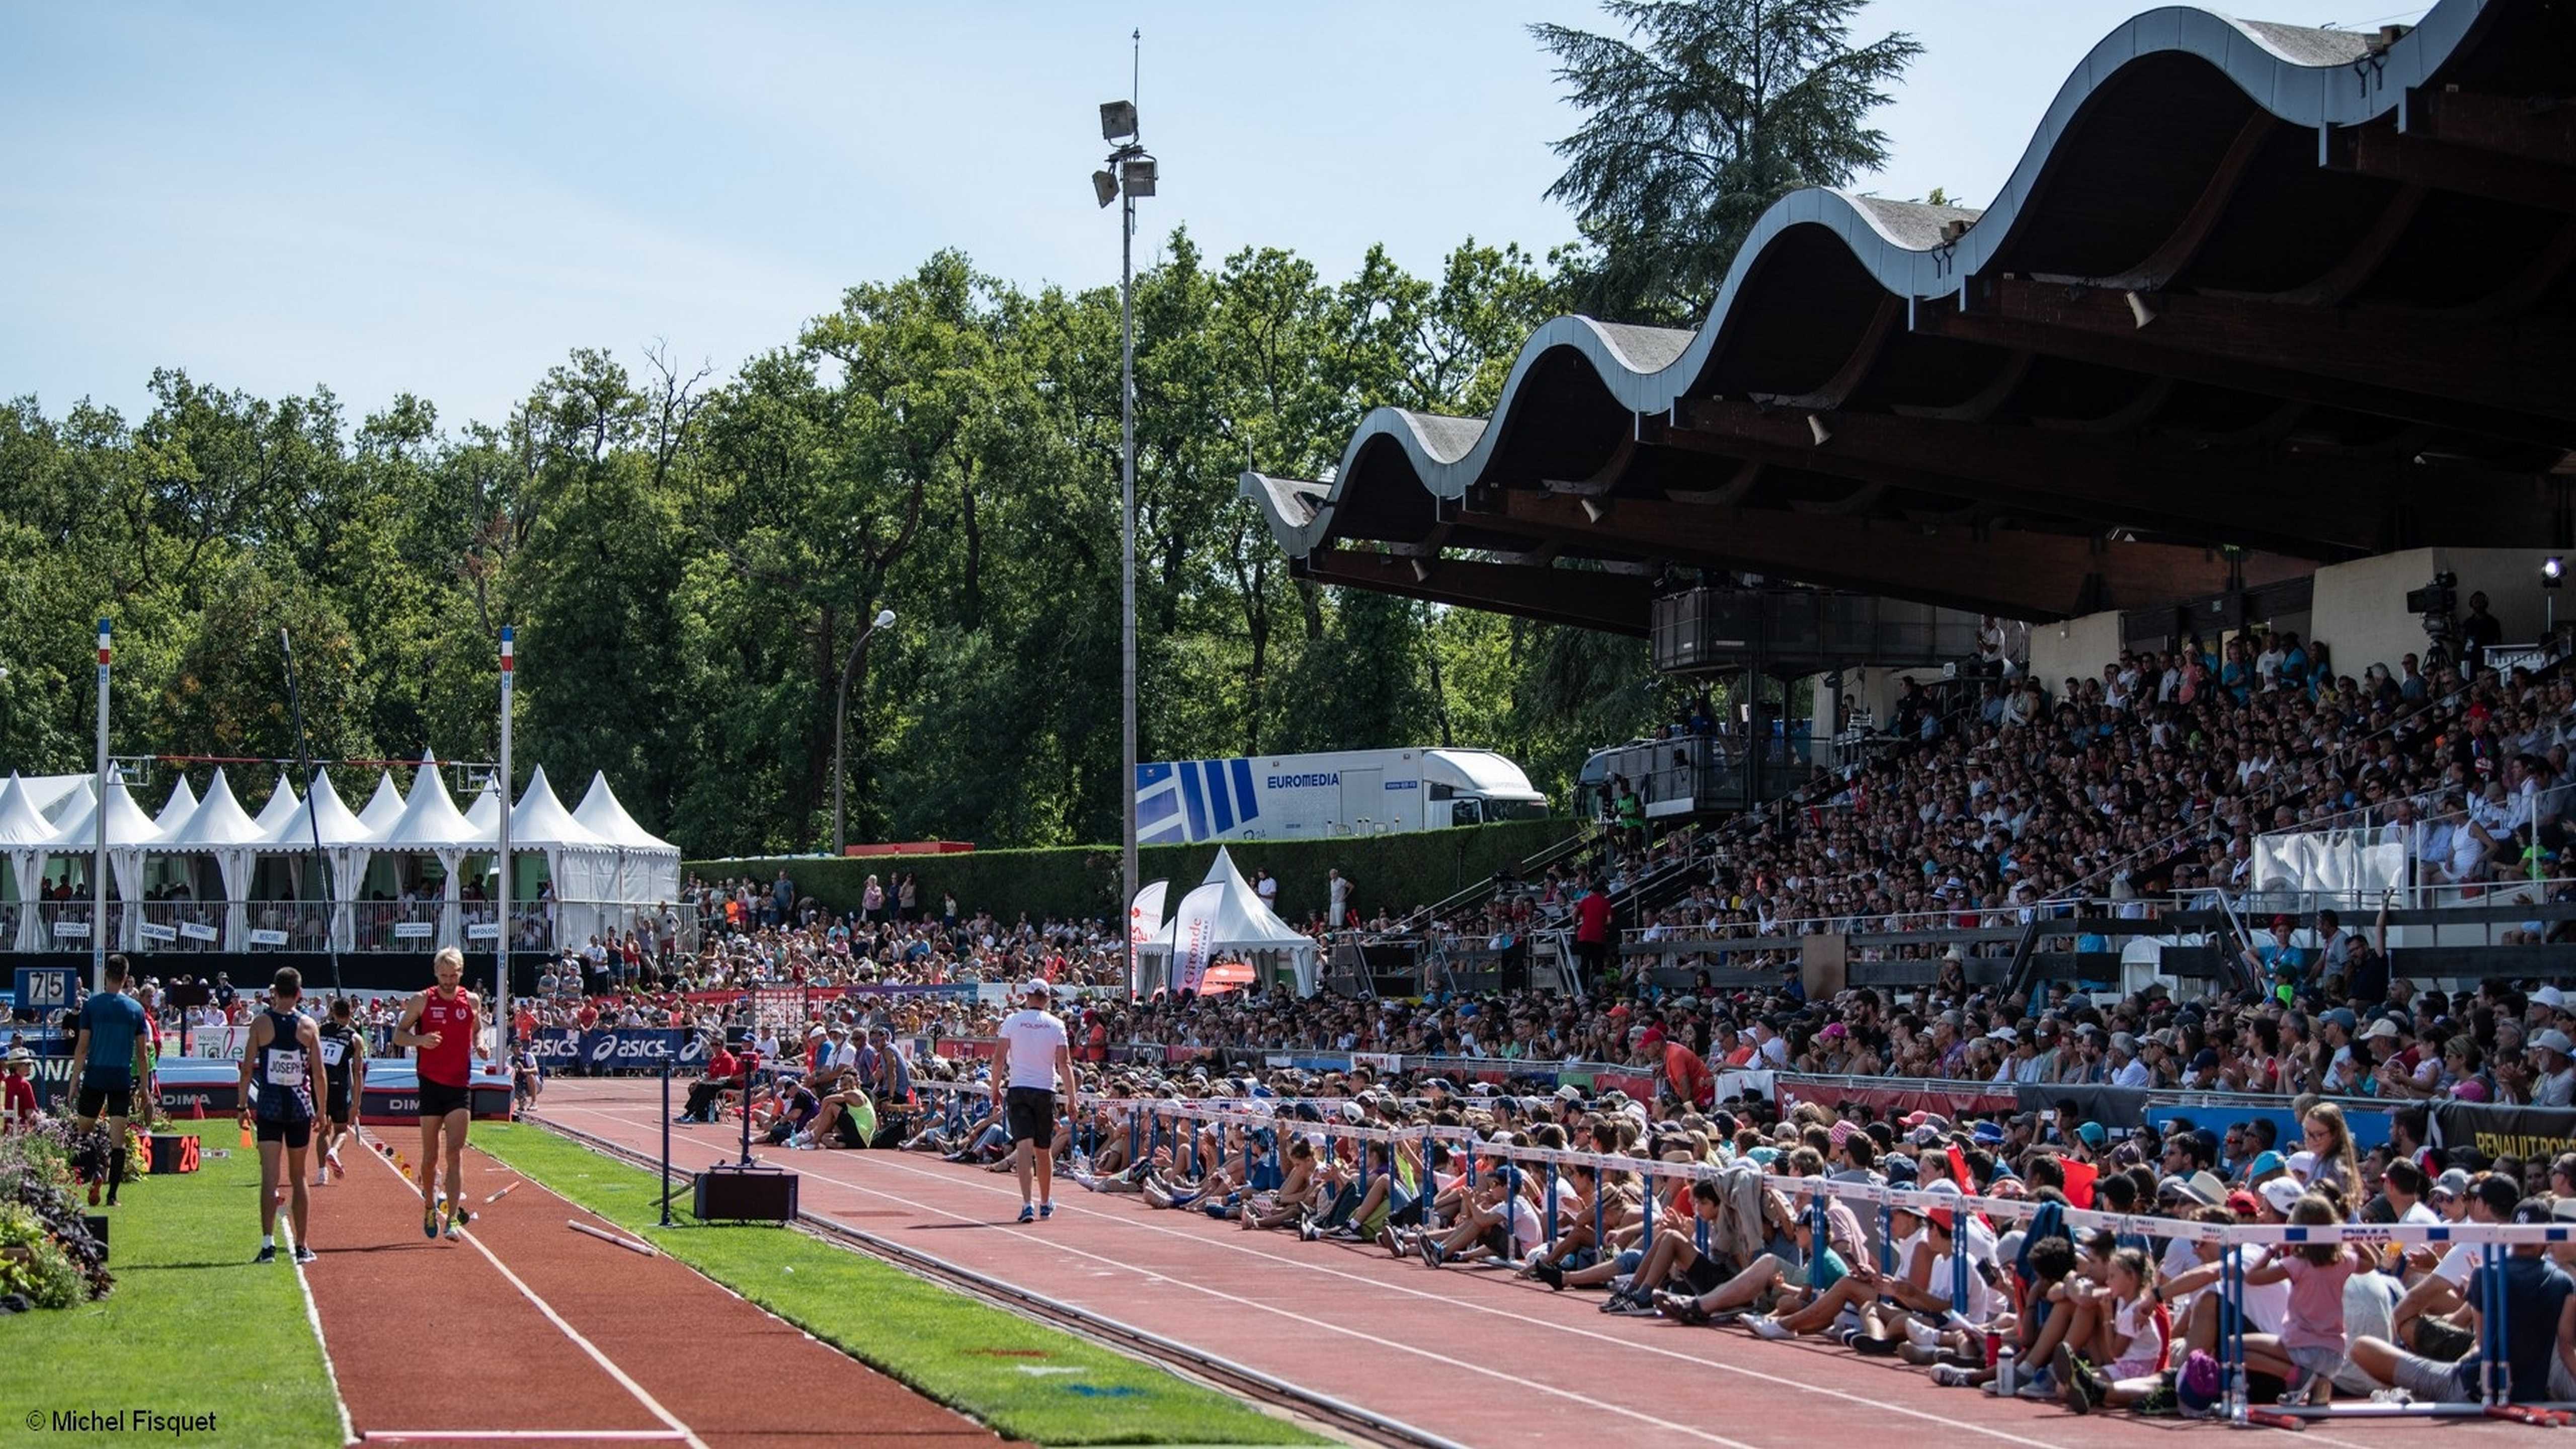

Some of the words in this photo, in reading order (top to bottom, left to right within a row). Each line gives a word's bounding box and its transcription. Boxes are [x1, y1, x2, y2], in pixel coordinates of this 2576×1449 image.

[1267, 773, 1339, 789] EUROMEDIA
[1184, 917, 1202, 984] Gironde
[31, 972, 63, 998] 75
[324, 1049, 335, 1057] 11
[270, 1061, 300, 1074] JOSEPH
[162, 1094, 211, 1105] DIMA
[389, 1099, 421, 1110] DIM
[179, 1135, 199, 1172] 26
